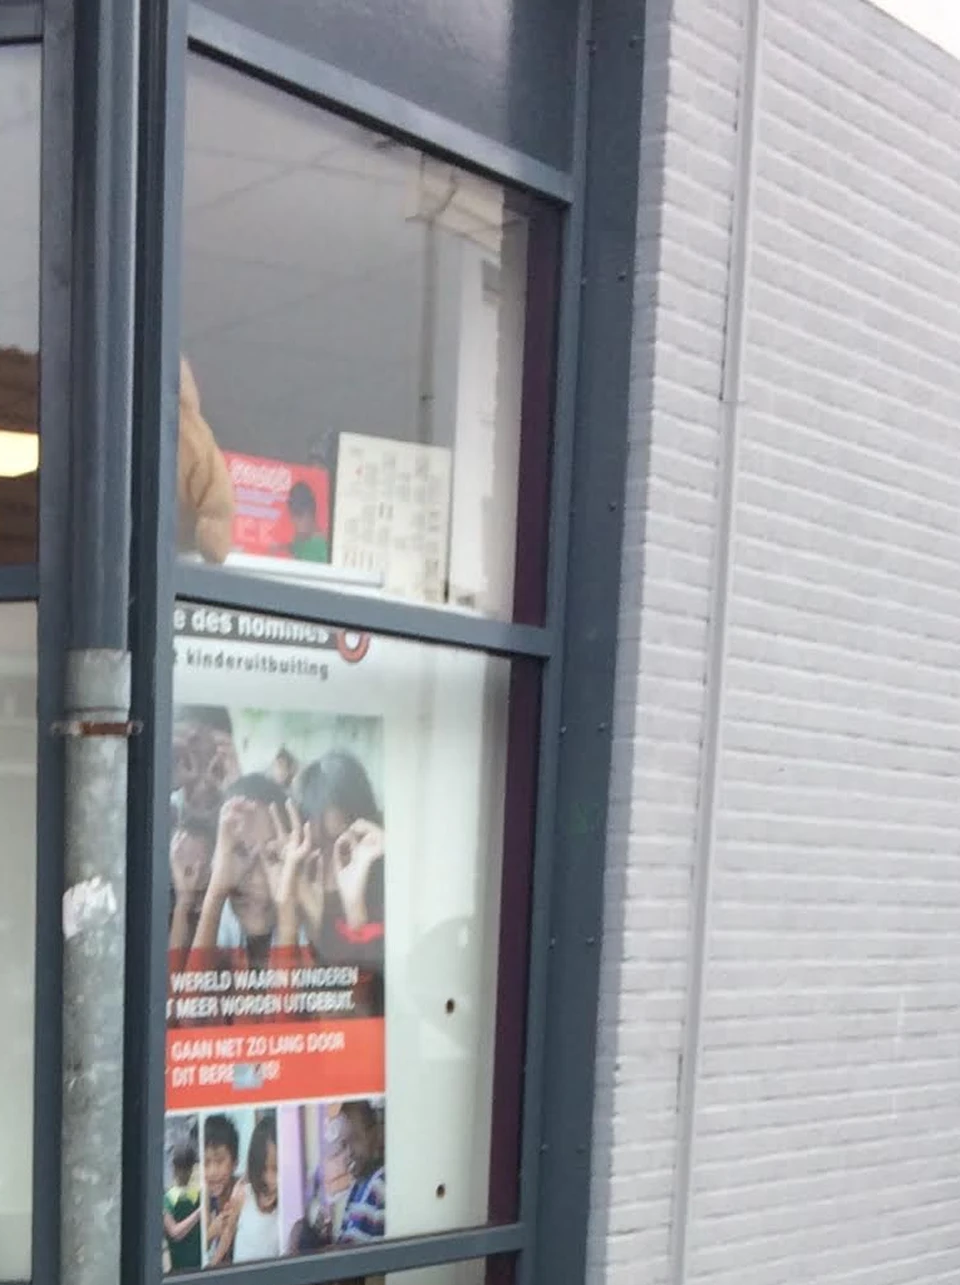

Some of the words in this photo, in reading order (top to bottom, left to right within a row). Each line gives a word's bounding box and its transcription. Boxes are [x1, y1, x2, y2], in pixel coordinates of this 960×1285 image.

[192, 608, 232, 635] des
[187, 648, 328, 681] kinderuitbuiting
[170, 969, 232, 993] WERELD
[233, 968, 289, 990] WAARIN
[290, 966, 359, 988] KINDEREN
[176, 995, 219, 1019] MEER
[220, 993, 282, 1017] WORDEN
[245, 1036, 268, 1057] ZO
[268, 1034, 305, 1055] LANG
[306, 1031, 346, 1053] DOOR
